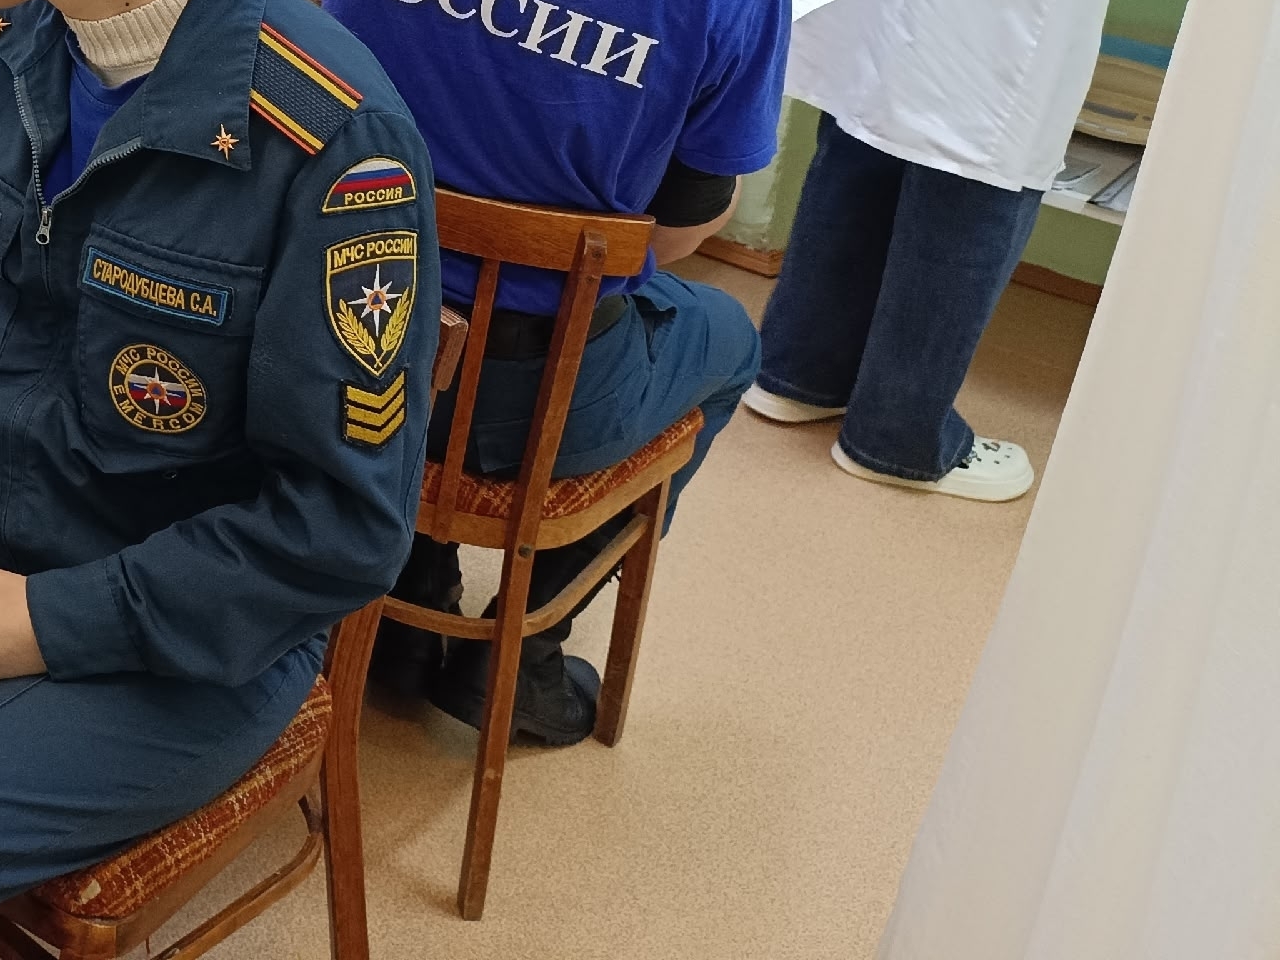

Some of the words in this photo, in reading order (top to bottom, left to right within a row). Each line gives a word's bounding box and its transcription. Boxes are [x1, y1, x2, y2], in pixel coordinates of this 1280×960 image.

[344, 186, 403, 205] РОССИЯ
[333, 243, 365, 268] МЧС
[366, 237, 413, 257] РОССИИ
[93, 258, 185, 310] СТАРОДУБЦЕВА
[190, 292, 217, 317] С.А.
[115, 348, 140, 375] МЧС
[147, 347, 203, 397] РОССИИ
[113, 384, 204, 430] EMERCOM
